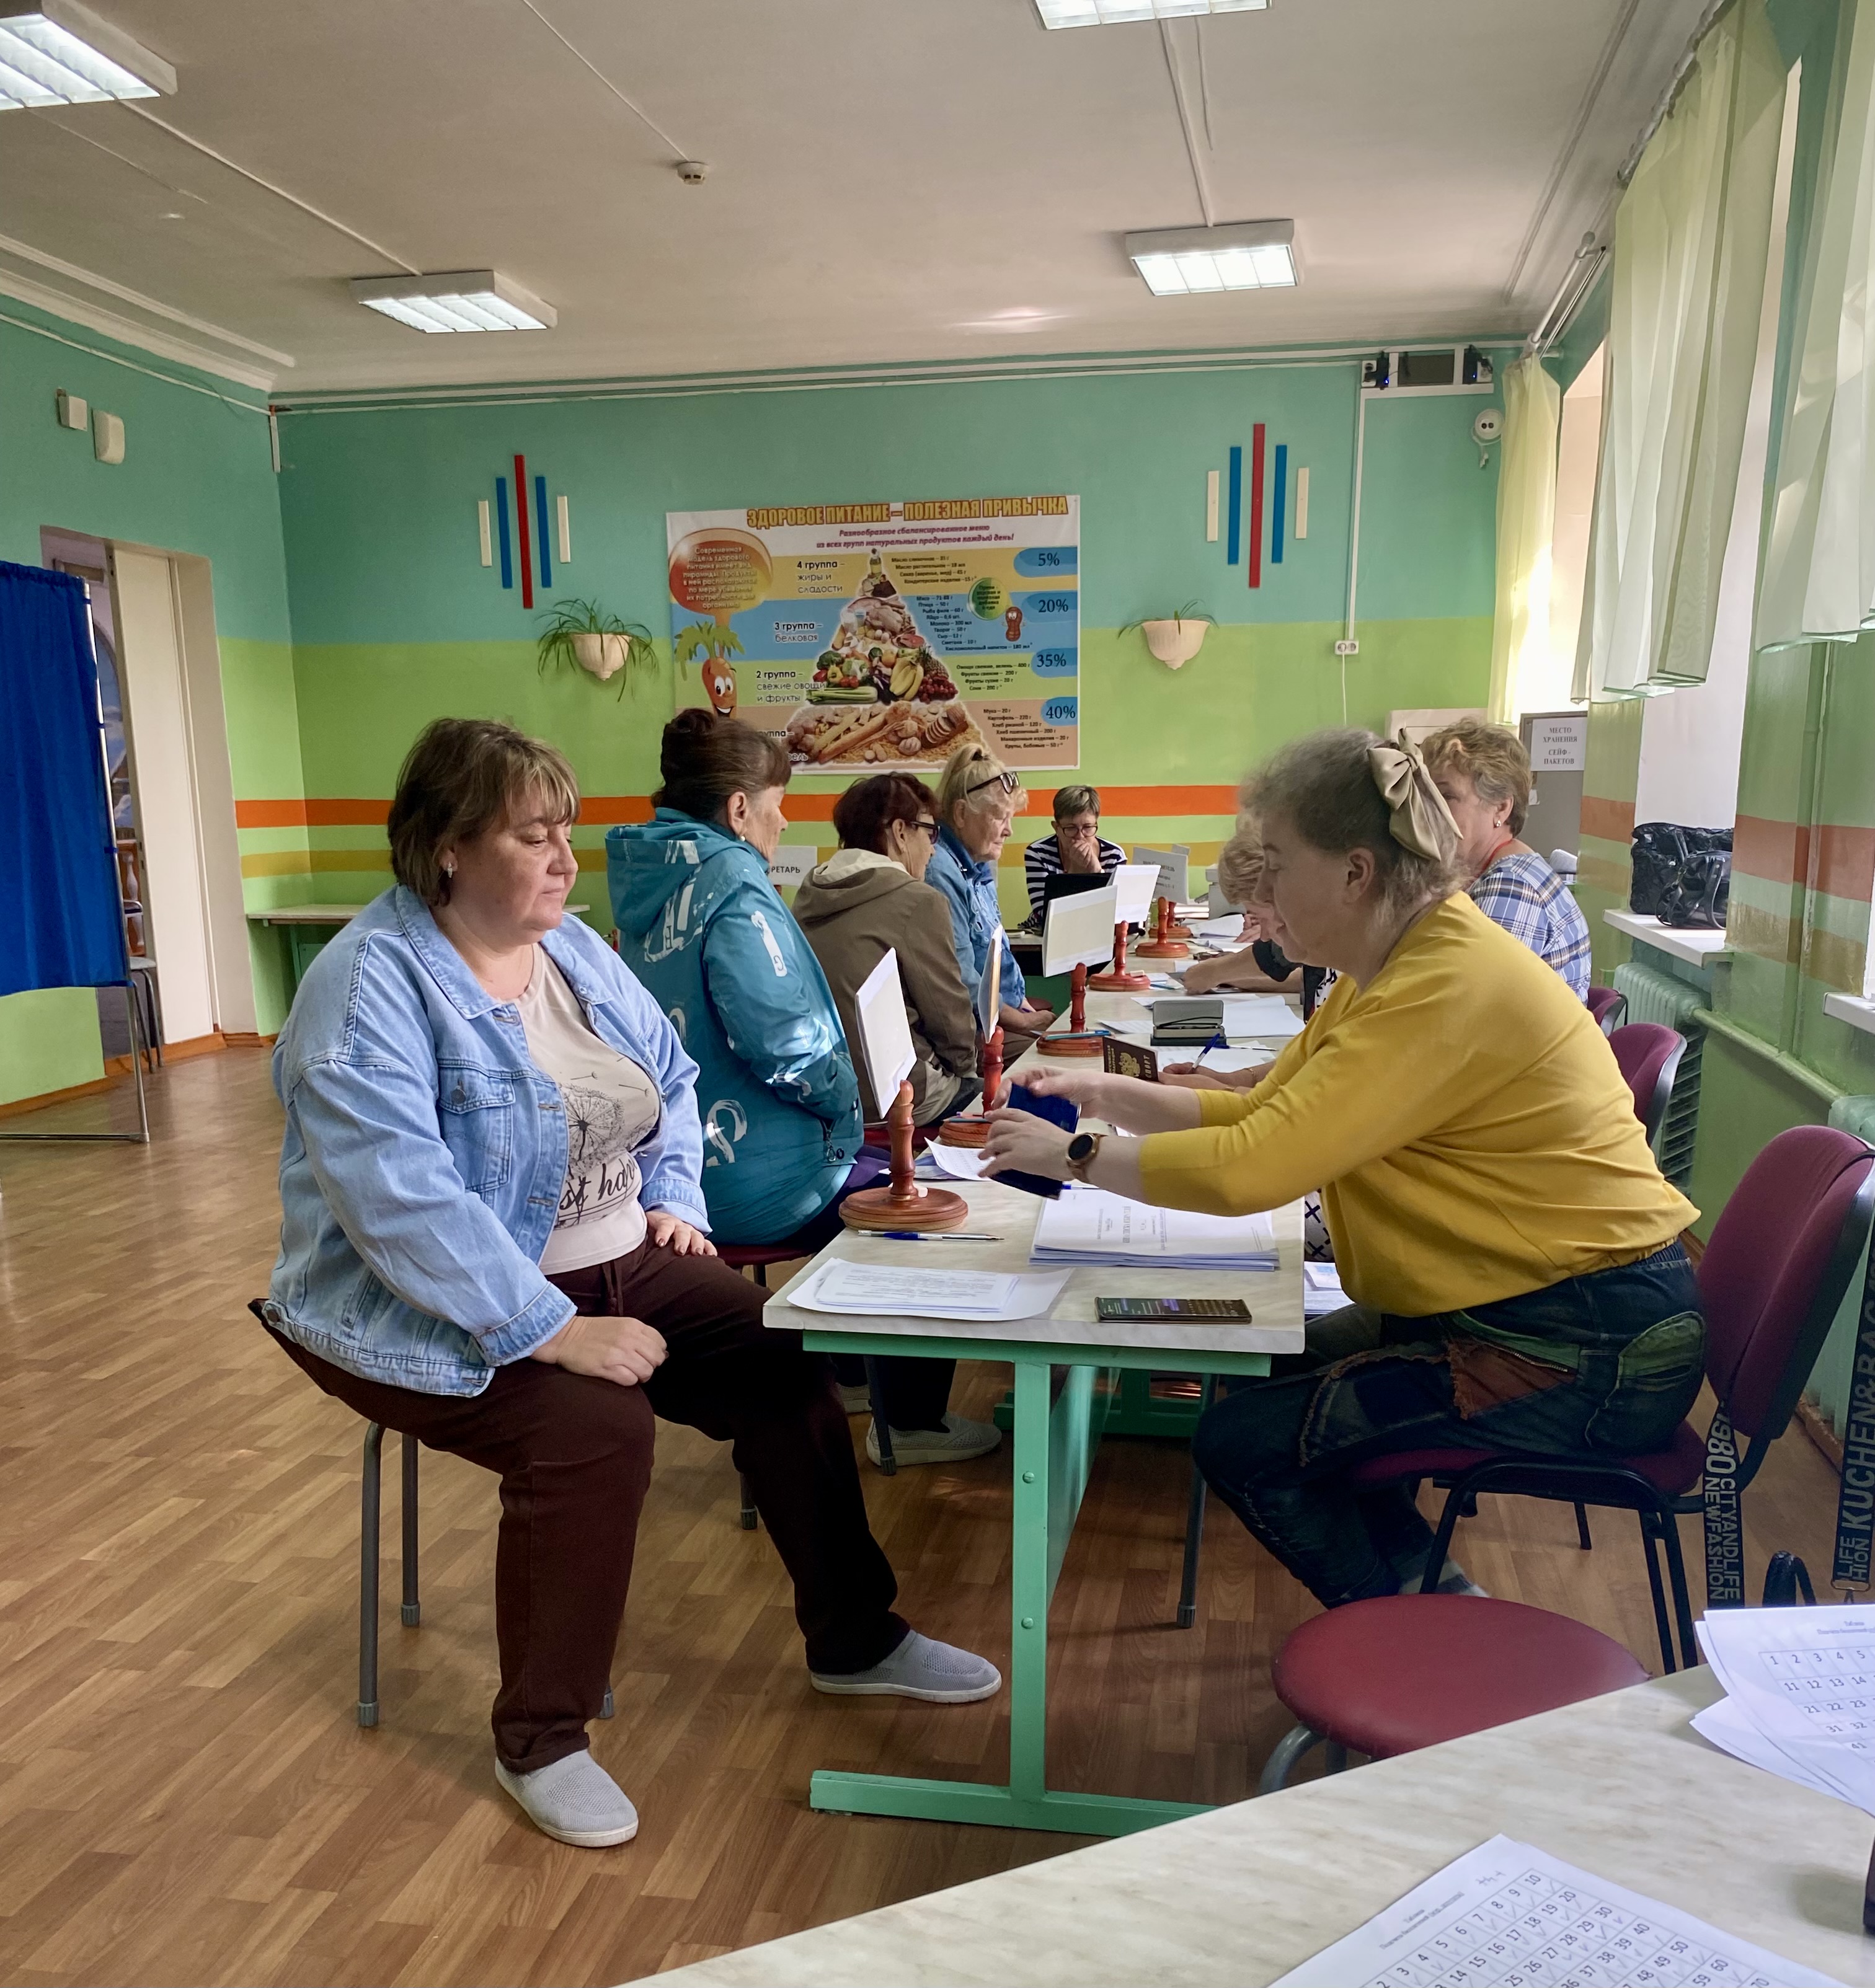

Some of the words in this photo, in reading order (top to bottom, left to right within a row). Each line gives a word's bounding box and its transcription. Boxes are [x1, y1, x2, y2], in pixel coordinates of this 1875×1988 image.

[747, 506, 825, 529] ЗДОРОВОЕ
[825, 503, 890, 524] ПИТАНИЕ
[903, 500, 980, 521] ПОЛЕЗНАЯ
[983, 496, 1068, 518] ПРИВЫЧКА
[840, 528, 896, 537] Разнообразное
[897, 526, 967, 535] сбалансированное
[843, 541, 864, 549] групп
[866, 538, 918, 547] натуральных
[919, 537, 961, 546] продуктов
[962, 534, 992, 544] каждый
[993, 533, 1014, 541] день!
[695, 546, 742, 555] Современная
[805, 561, 838, 570] группа
[1038, 552, 1060, 567] 5%
[1039, 598, 1068, 613] 20%
[774, 622, 779, 630] 3
[782, 622, 815, 632] группа
[775, 634, 818, 642] белковая
[1037, 653, 1066, 668] 35%
[764, 671, 796, 680] группа
[766, 694, 800, 704] фрукты
[1046, 705, 1076, 719] 40%
[760, 730, 786, 738] уппа
[1837, 1536, 1856, 1578] LIFE
[1770, 1655, 1779, 1665] 1
[1791, 1654, 1801, 1663] 2
[1813, 1653, 1822, 1662] 3
[1837, 1651, 1844, 1660] 4
[1856, 1650, 1866, 1659] 5
[1784, 1682, 1799, 1692] 11
[1807, 1681, 1822, 1689] 12
[1829, 1678, 1845, 1687] 13
[1851, 1676, 1867, 1684] 14
[1804, 1705, 1821, 1713] 21
[1827, 1703, 1844, 1711] 22
[1850, 1700, 1866, 1708] 23
[1396, 1967, 1409, 1976] 3
[1417, 1953, 1429, 1961] 4
[1435, 1940, 1448, 1948] 5
[1455, 1926, 1467, 1935] 6
[1472, 1913, 1484, 1921] 7
[1491, 1901, 1504, 1909] 8
[1509, 1888, 1520, 1897] 9
[1524, 1873, 1541, 1886] 10
[1450, 1969, 1468, 1982] 14
[1469, 1956, 1486, 1968] 15
[1487, 1942, 1505, 1955] 16
[1506, 1928, 1522, 1942] 17
[1524, 1916, 1541, 1928] 18
[1541, 1903, 1558, 1916] 19
[1558, 1889, 1577, 1903] 20
[1505, 1974, 1523, 1987] 25
[1523, 1960, 1542, 1973] 26
[1541, 1946, 1559, 1959] 27
[1559, 1933, 1578, 1946] 28
[1577, 1920, 1595, 1932] 29
[1594, 1906, 1613, 1919] 30
[1579, 1964, 1597, 1977] 37
[1597, 1951, 1615, 1964] 38
[1614, 1937, 1633, 1950] 39
[1633, 1923, 1650, 1935] 40
[1636, 1969, 1654, 1982] 48
[1654, 1956, 1671, 1968] 49
[1670, 1941, 1689, 1954] 50
[1692, 1974, 1711, 1987] 59
[1711, 1959, 1729, 1972] 60
